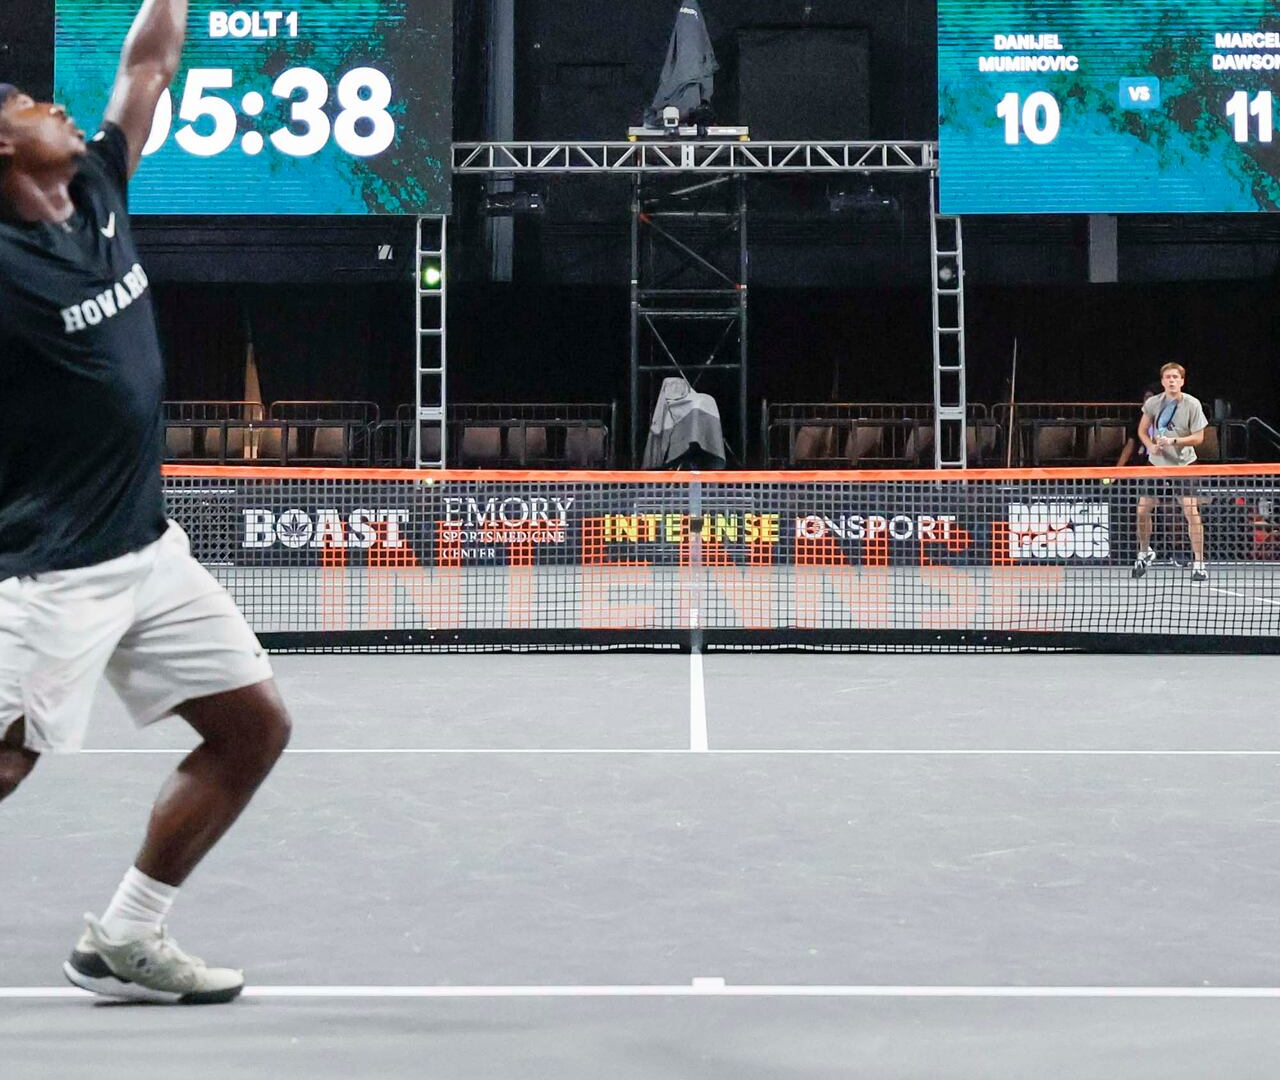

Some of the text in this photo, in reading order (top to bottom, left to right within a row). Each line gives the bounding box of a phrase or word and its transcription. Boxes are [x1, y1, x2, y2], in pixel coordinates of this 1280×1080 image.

[208, 10, 299, 38] BOLT 1
[993, 33, 1064, 51] DANIJEL
[978, 55, 1080, 73] MUMINOVIC
[1128, 85, 1151, 102] VS
[995, 91, 1062, 145] 10
[1225, 90, 1274, 143] 11
[442, 497, 575, 527] EMORY
[241, 508, 411, 549] BOAST
[442, 531, 566, 543] SPORTS MEDICINE
